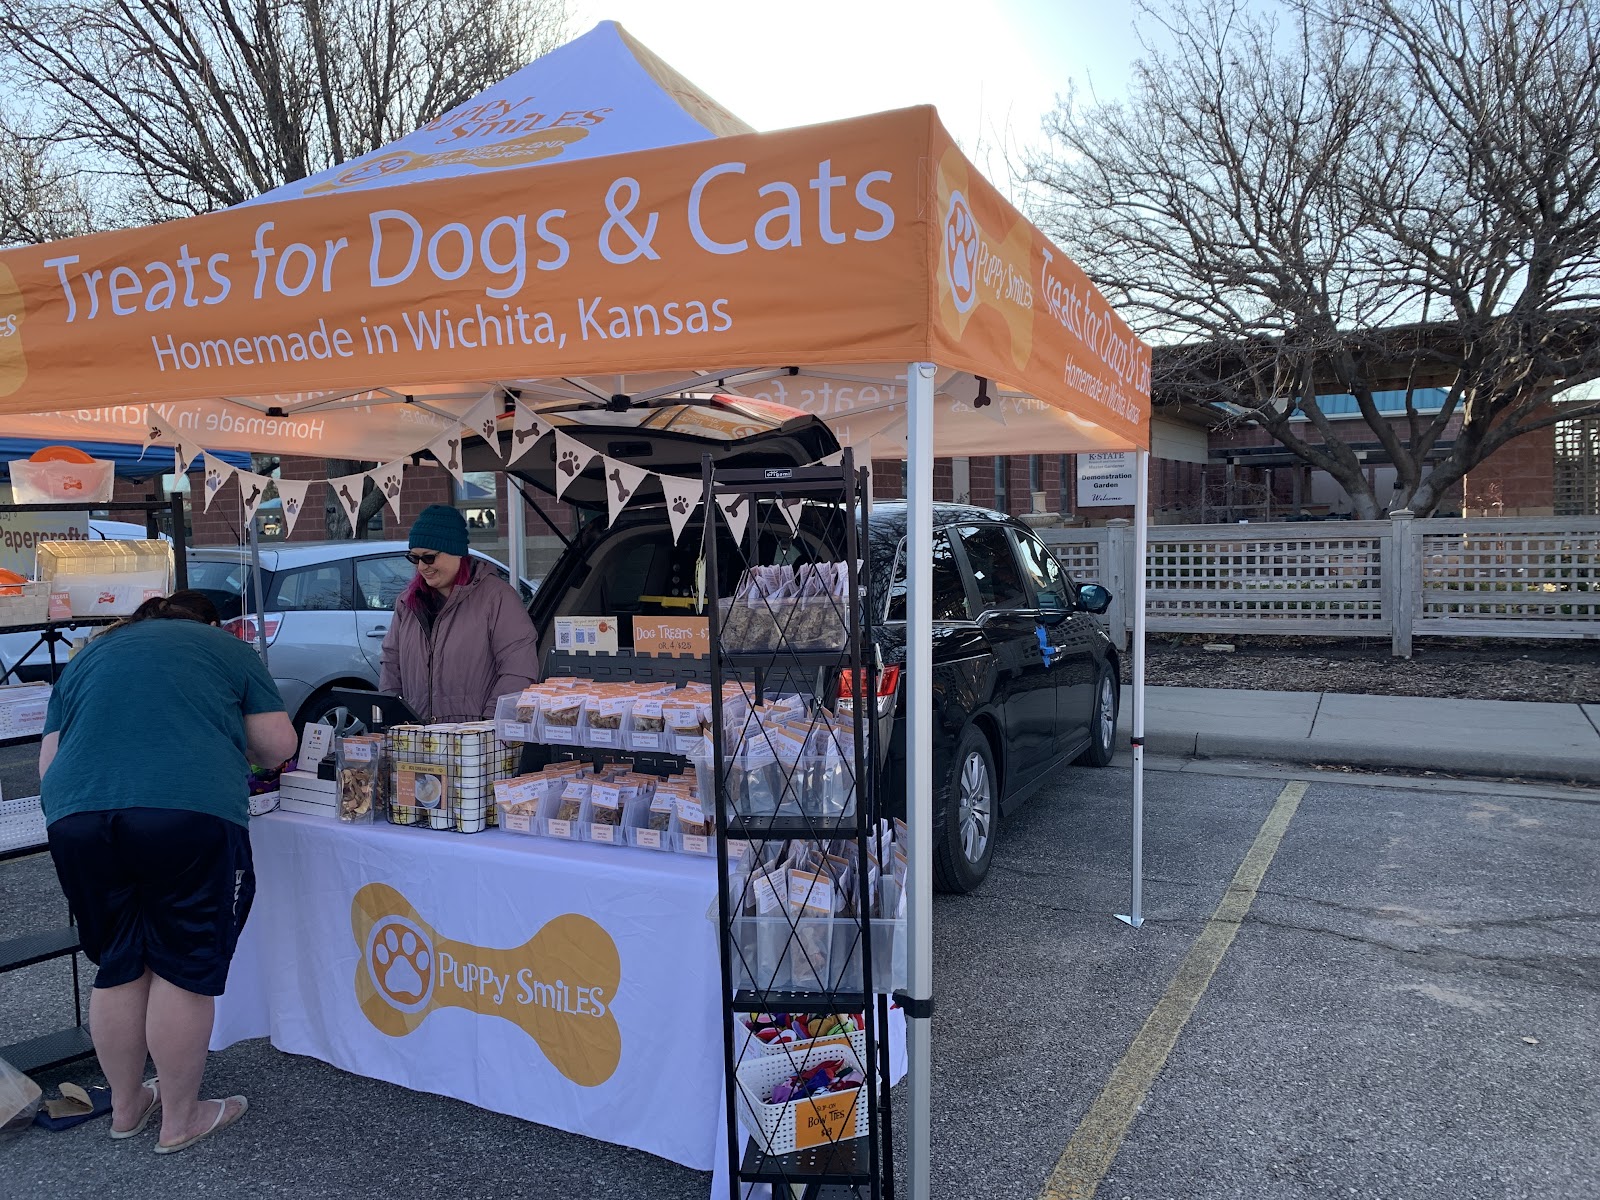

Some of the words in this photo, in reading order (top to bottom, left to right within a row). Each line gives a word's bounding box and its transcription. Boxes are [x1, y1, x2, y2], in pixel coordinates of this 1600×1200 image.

[44, 244, 231, 323] Treats
[251, 221, 348, 299] for
[369, 209, 570, 299] Dogs
[598, 176, 661, 265] &
[687, 158, 895, 255] Cats
[151, 319, 354, 372] Homemade
[361, 316, 399, 354] in
[402, 303, 568, 350] Wichita,
[577, 296, 733, 341] Kansas
[1041, 247, 1083, 341] Treats
[1084, 290, 1102, 355] for
[1100, 310, 1128, 387] Dogs
[1126, 337, 1135, 385] &
[1135, 346, 1151, 398] Cats
[1064, 352, 1103, 402] Homemade
[1100, 378, 1110, 405] in
[1109, 382, 1125, 420] Wichita,
[1124, 396, 1140, 426] Kansas
[637, 627, 656, 640] DOG
